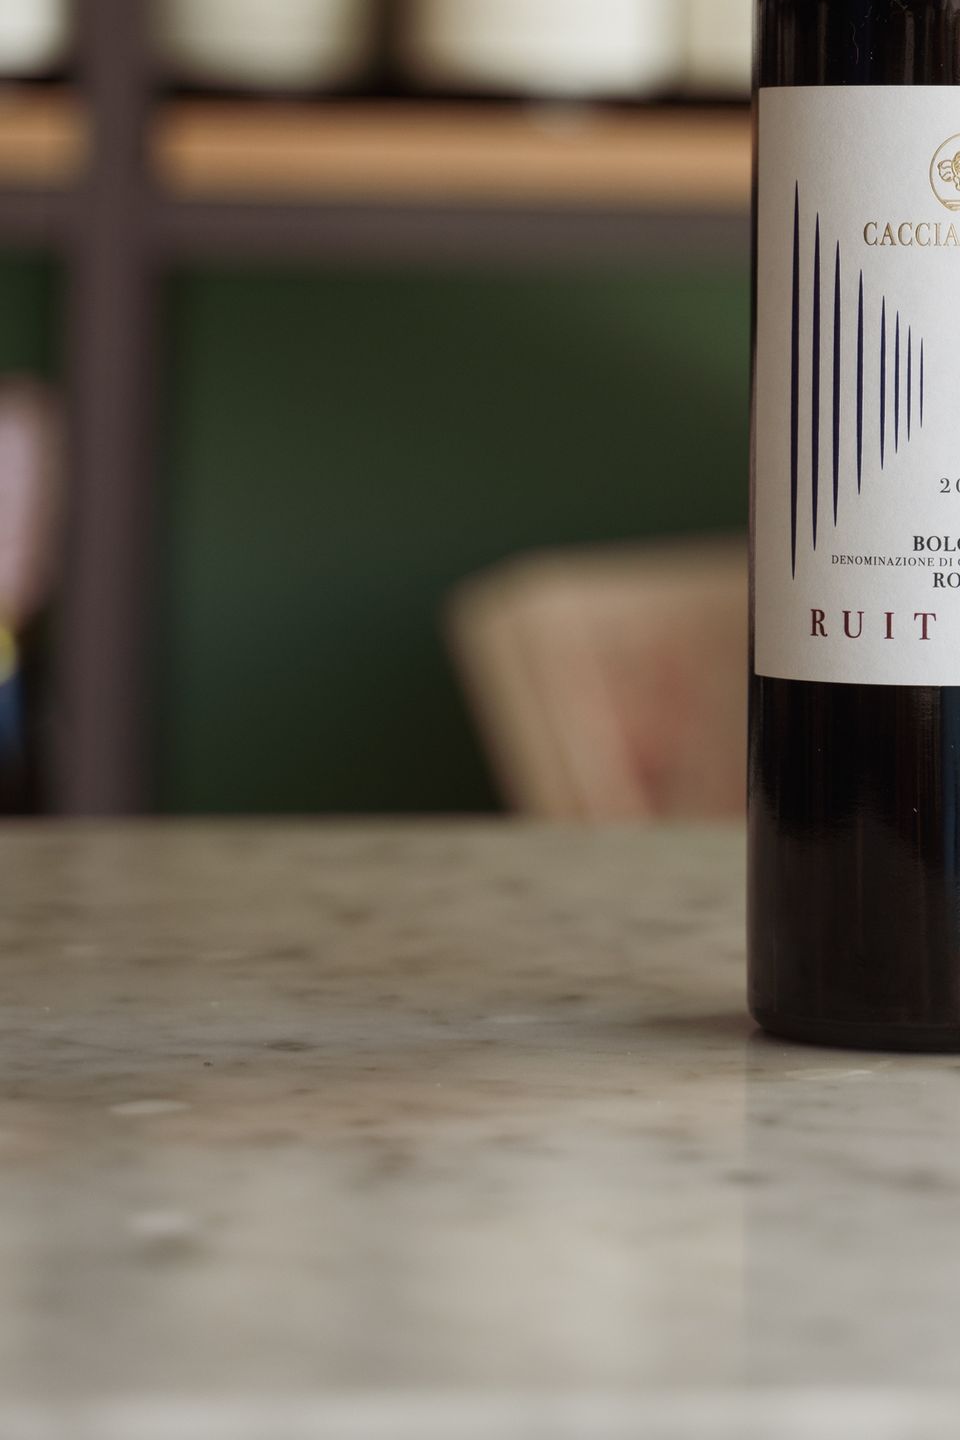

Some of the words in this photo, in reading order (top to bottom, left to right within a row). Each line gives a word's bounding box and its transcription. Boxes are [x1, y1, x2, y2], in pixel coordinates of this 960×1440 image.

[863, 221, 960, 247] CACCIA
[831, 554, 936, 568] DENOMINAZIONE
[938, 556, 954, 568] DI
[810, 608, 937, 641] RUIT
